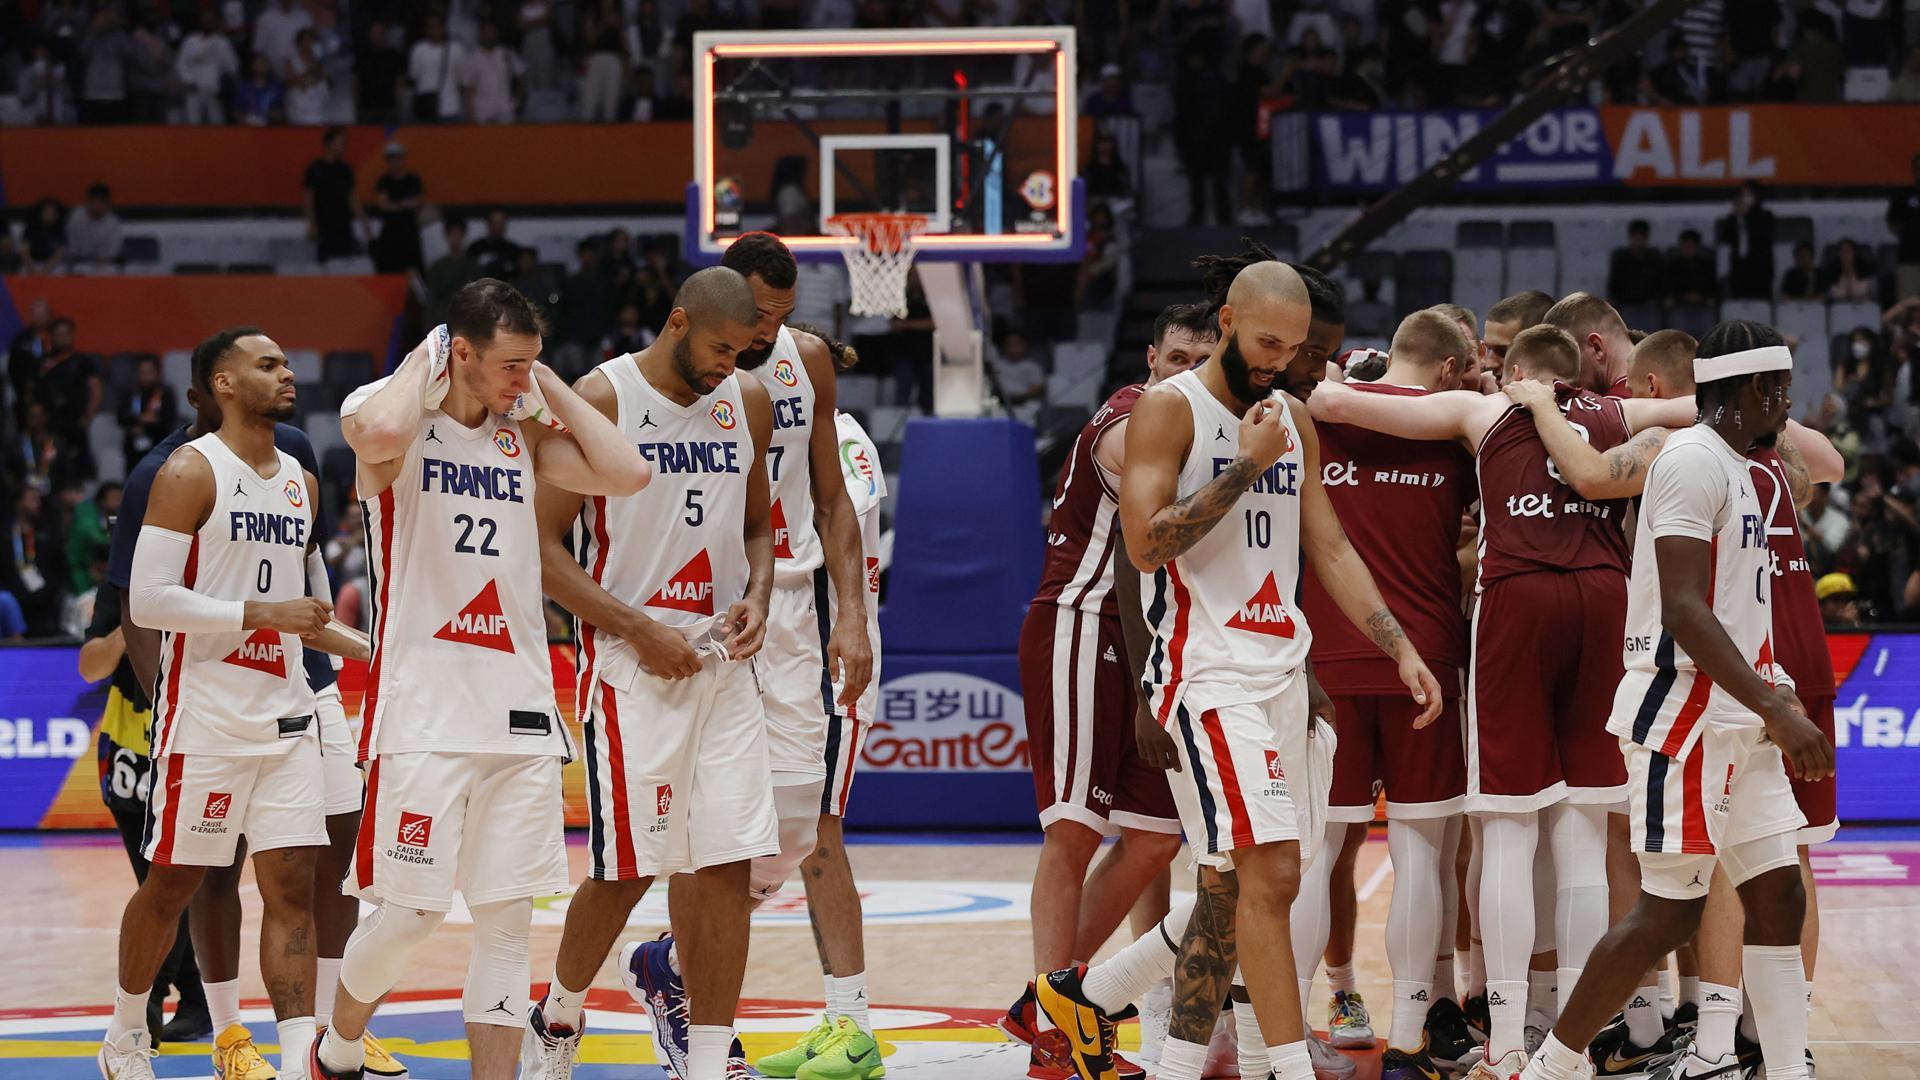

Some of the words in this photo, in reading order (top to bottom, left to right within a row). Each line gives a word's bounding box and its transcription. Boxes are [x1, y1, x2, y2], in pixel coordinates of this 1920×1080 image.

[1497, 111, 1599, 156] OR
[1613, 111, 1775, 178] ALL
[638, 442, 740, 474] FRANCE
[768, 446, 785, 482] 7
[421, 457, 524, 504] FRANCE
[685, 489, 704, 527] 5
[1506, 493, 1555, 518] tet
[230, 511, 305, 549] FRANCE
[453, 513, 500, 557] 22
[1245, 509, 1271, 549] 10
[257, 559, 273, 593] 0
[661, 582, 713, 601] MAIF
[450, 613, 507, 635] MAIF
[1239, 603, 1288, 624] MAIF
[238, 643, 283, 663] MAIF
[883, 689, 1004, 722] 百岁山
[387, 849, 434, 865] D'EPARGNE
[396, 845, 425, 857] CAISSE
